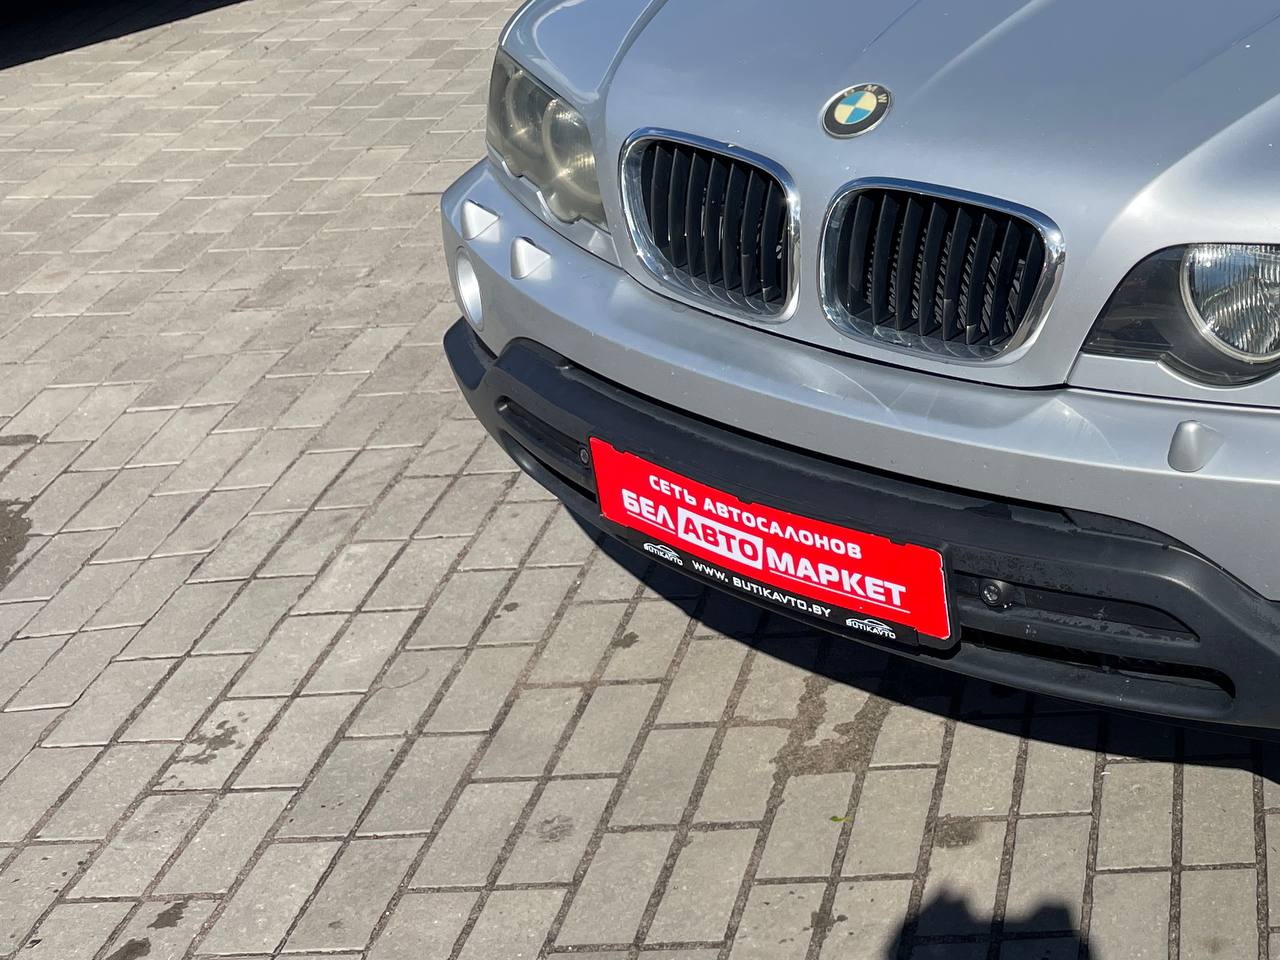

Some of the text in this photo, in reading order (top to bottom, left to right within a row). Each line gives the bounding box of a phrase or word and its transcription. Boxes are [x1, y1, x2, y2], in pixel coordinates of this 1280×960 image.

[622, 488, 907, 607] БЕЛ АВТО МАРКЕТ
[648, 474, 862, 560] СЕТЬ АВТОСАЛОНОВ
[691, 560, 831, 617] WWW. BUTIKAVTO.BY
